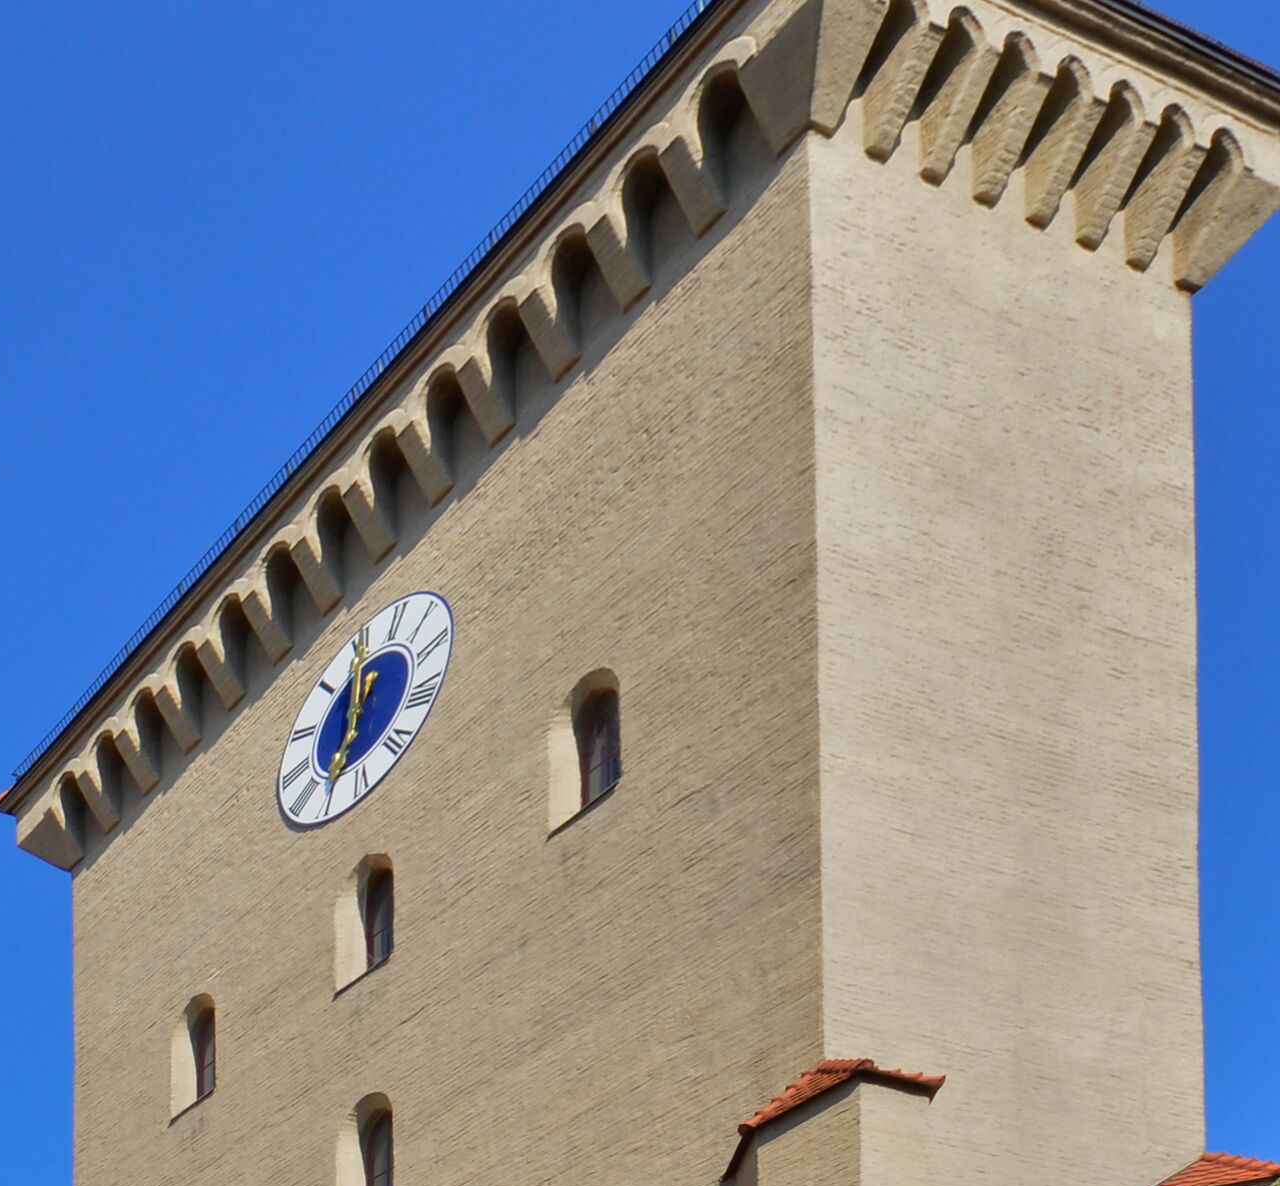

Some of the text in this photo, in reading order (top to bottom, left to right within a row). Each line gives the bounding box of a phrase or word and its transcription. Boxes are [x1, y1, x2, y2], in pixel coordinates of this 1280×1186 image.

[404, 670, 442, 711] VIII
[290, 722, 318, 745] II
[382, 728, 415, 758] VII
[282, 756, 310, 793] III
[354, 764, 369, 799] VI
